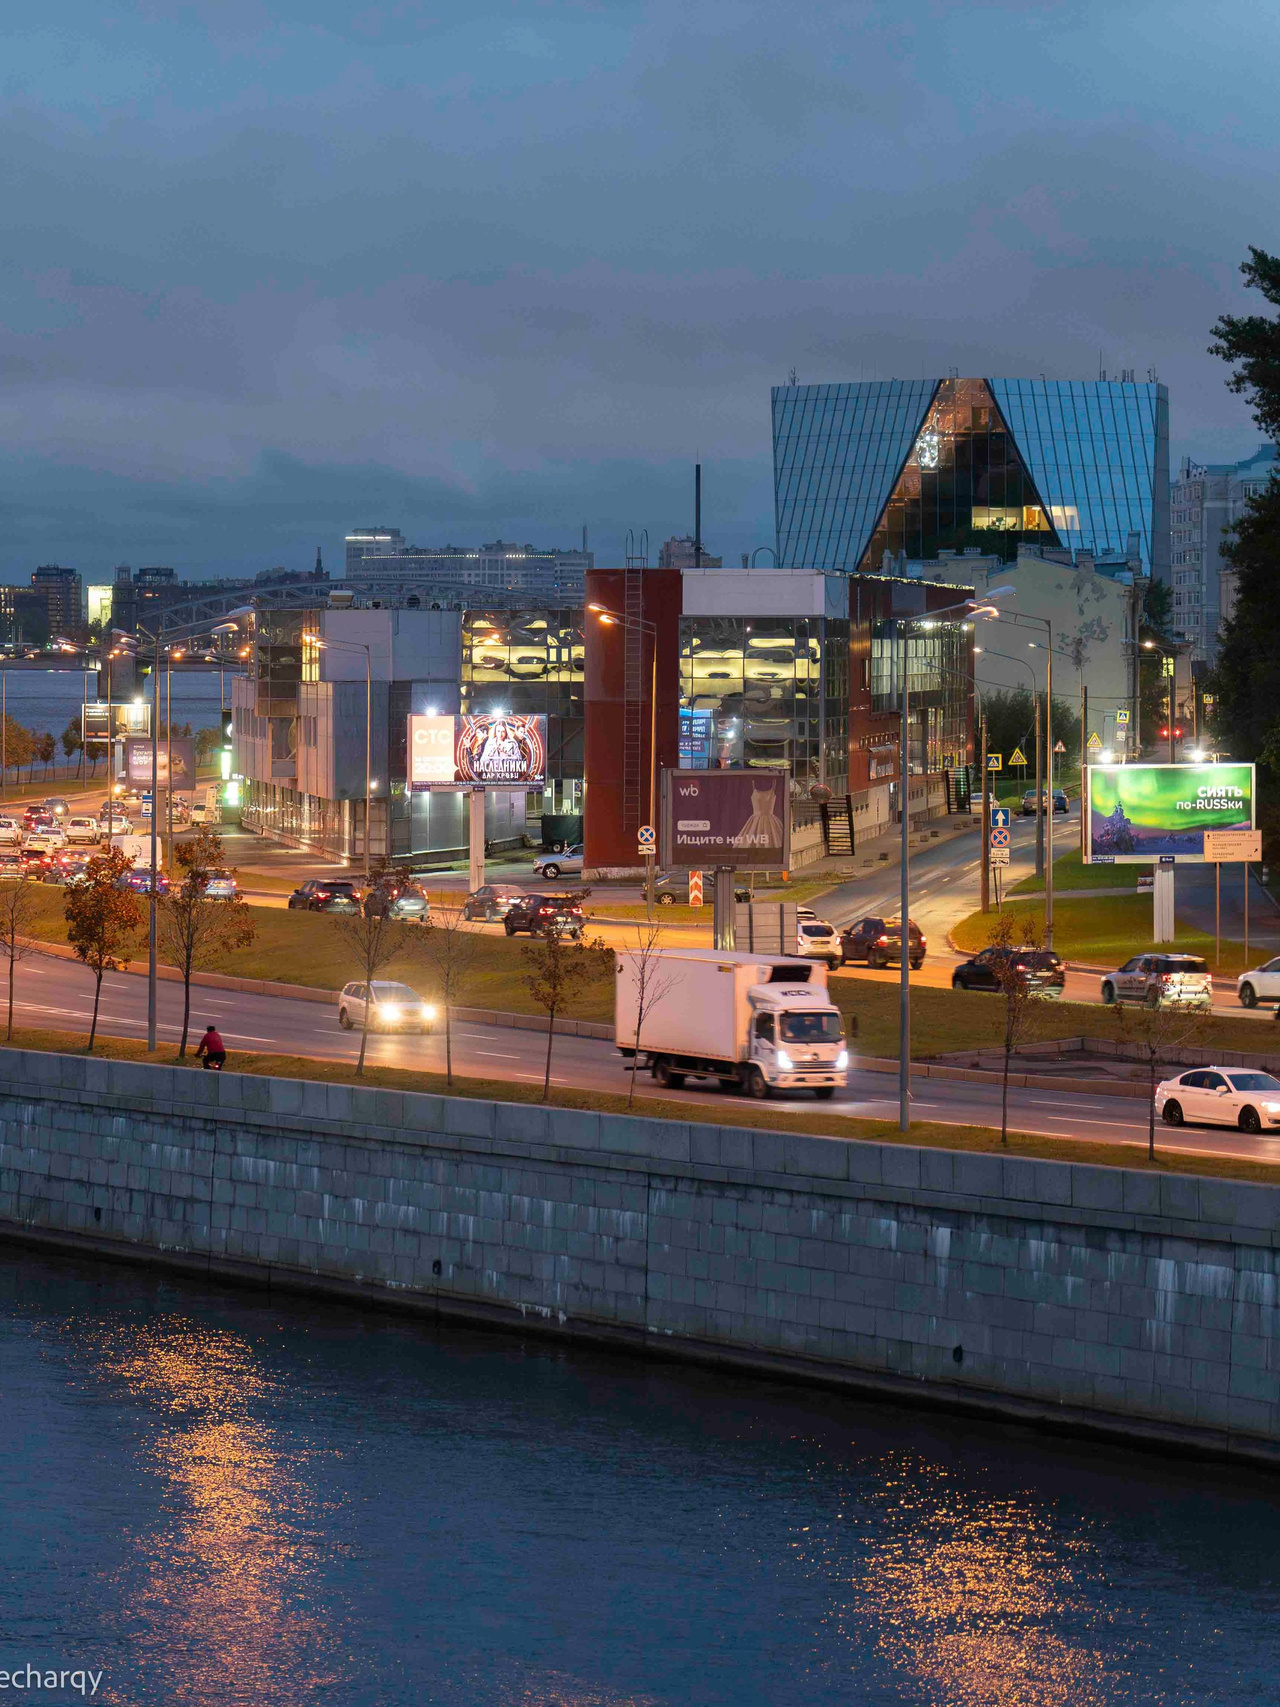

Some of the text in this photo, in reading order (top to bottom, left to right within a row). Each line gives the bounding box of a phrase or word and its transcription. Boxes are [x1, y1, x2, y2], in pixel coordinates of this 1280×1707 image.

[414, 729, 452, 745] СТС
[473, 760, 527, 773] НАСЛЕДНИКИ
[679, 784, 699, 797] wb
[1176, 799, 1243, 810] по-RUSSки
[677, 834, 769, 846] Ищите на WB
